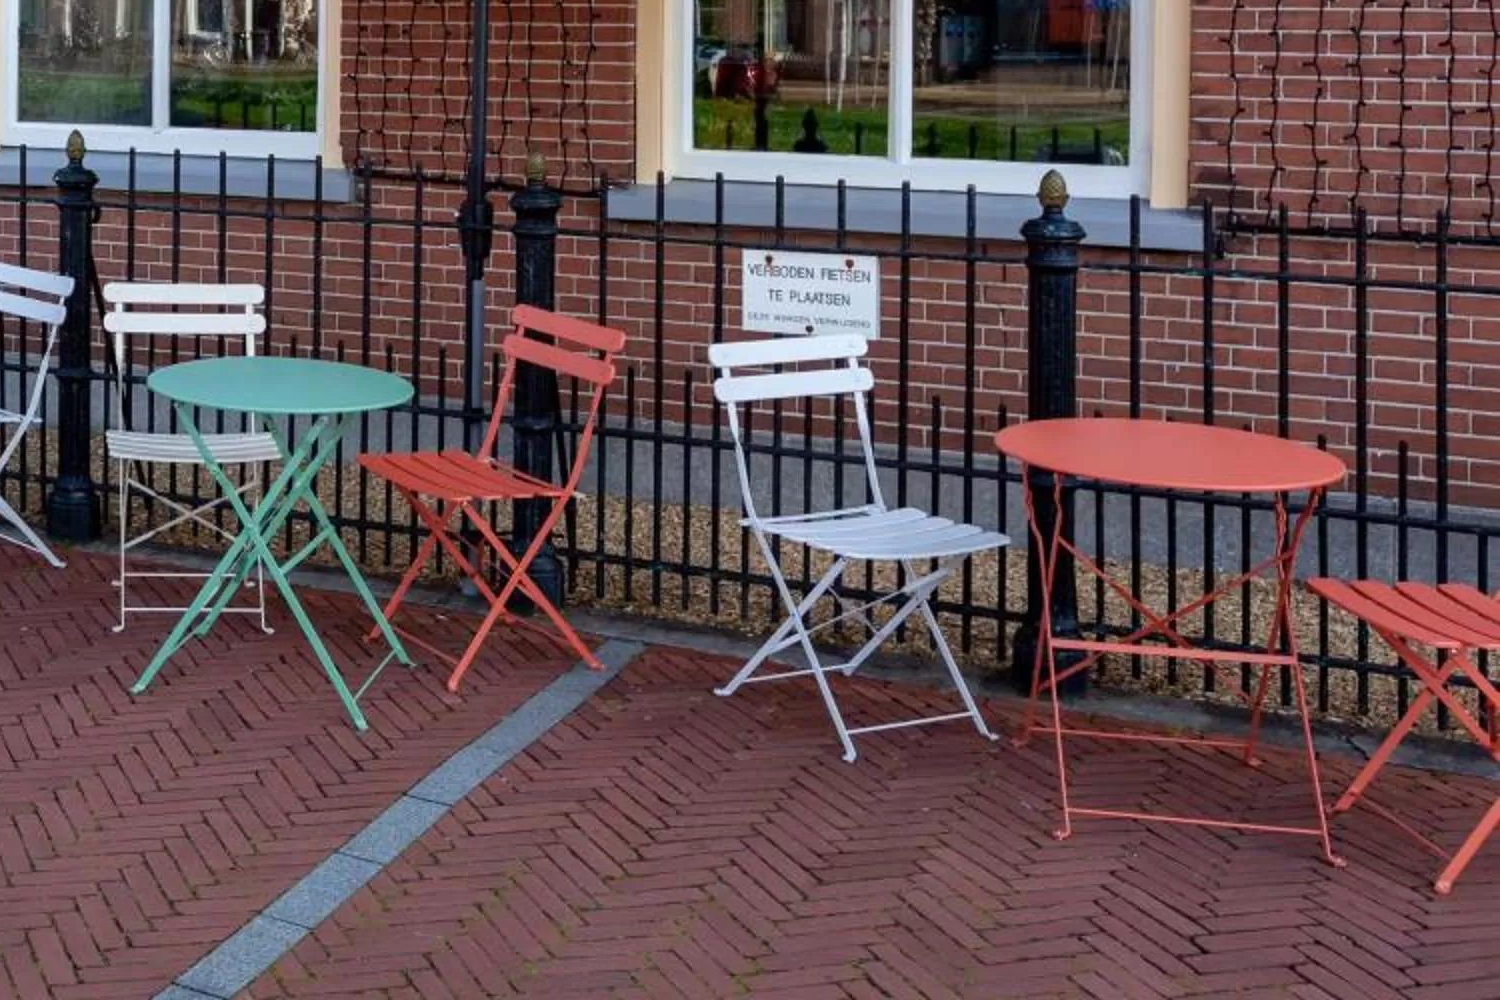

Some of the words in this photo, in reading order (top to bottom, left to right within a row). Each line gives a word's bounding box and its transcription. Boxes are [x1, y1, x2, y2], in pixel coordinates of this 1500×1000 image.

[747, 263, 815, 281] VERBODEN
[820, 267, 871, 284] FIETSEN
[767, 288, 783, 302] TE
[789, 290, 851, 306] PLAATSEN
